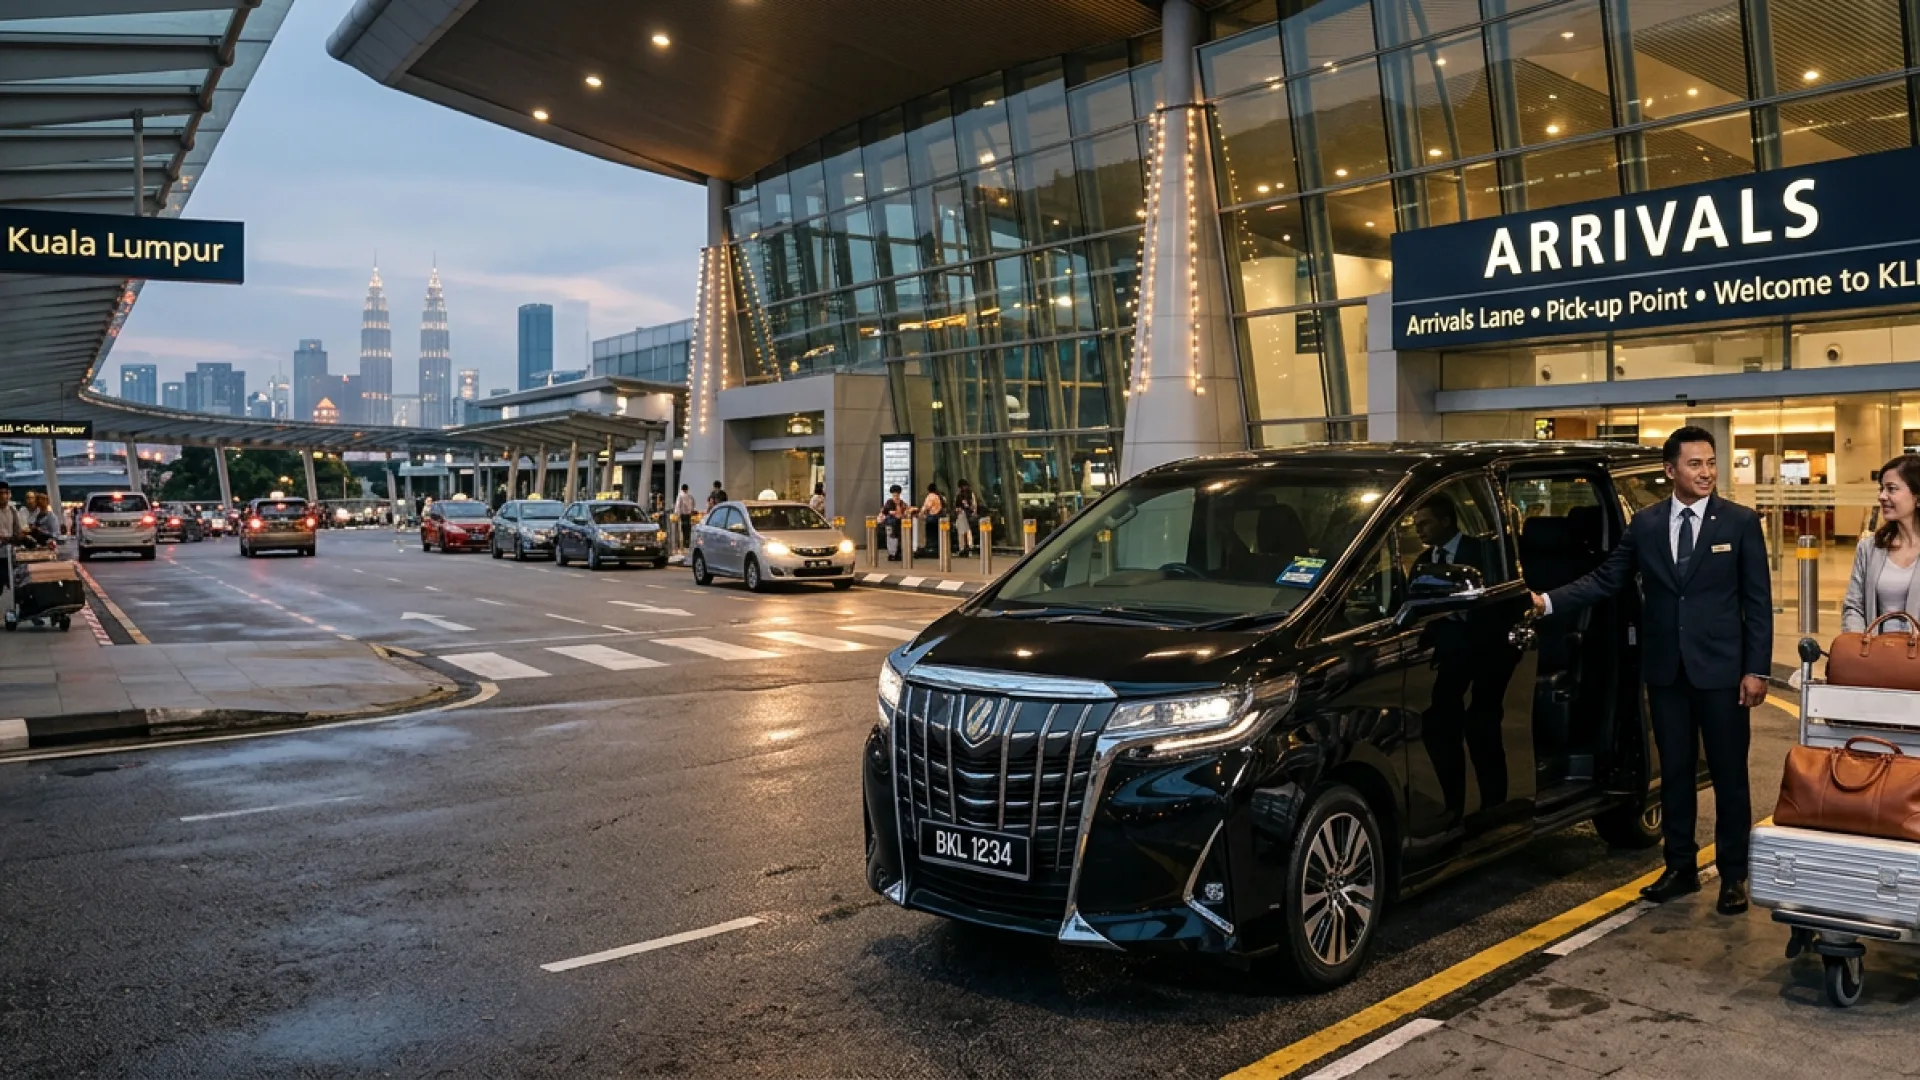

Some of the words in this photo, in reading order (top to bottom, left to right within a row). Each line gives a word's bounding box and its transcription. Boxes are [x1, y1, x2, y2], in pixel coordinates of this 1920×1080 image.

[8, 226, 95, 256] Kuala
[107, 232, 224, 267] Lumpur
[1484, 179, 1820, 279] ARRIVALS
[1406, 308, 1475, 336] Arrivals
[1480, 306, 1526, 329] Lane
[1546, 295, 1623, 322] Pick-up
[1629, 287, 1688, 313] Point
[1713, 275, 1833, 305] Welcome
[1839, 269, 1870, 292] to
[936, 830, 968, 859] BKL
[971, 836, 1013, 867] 1234
